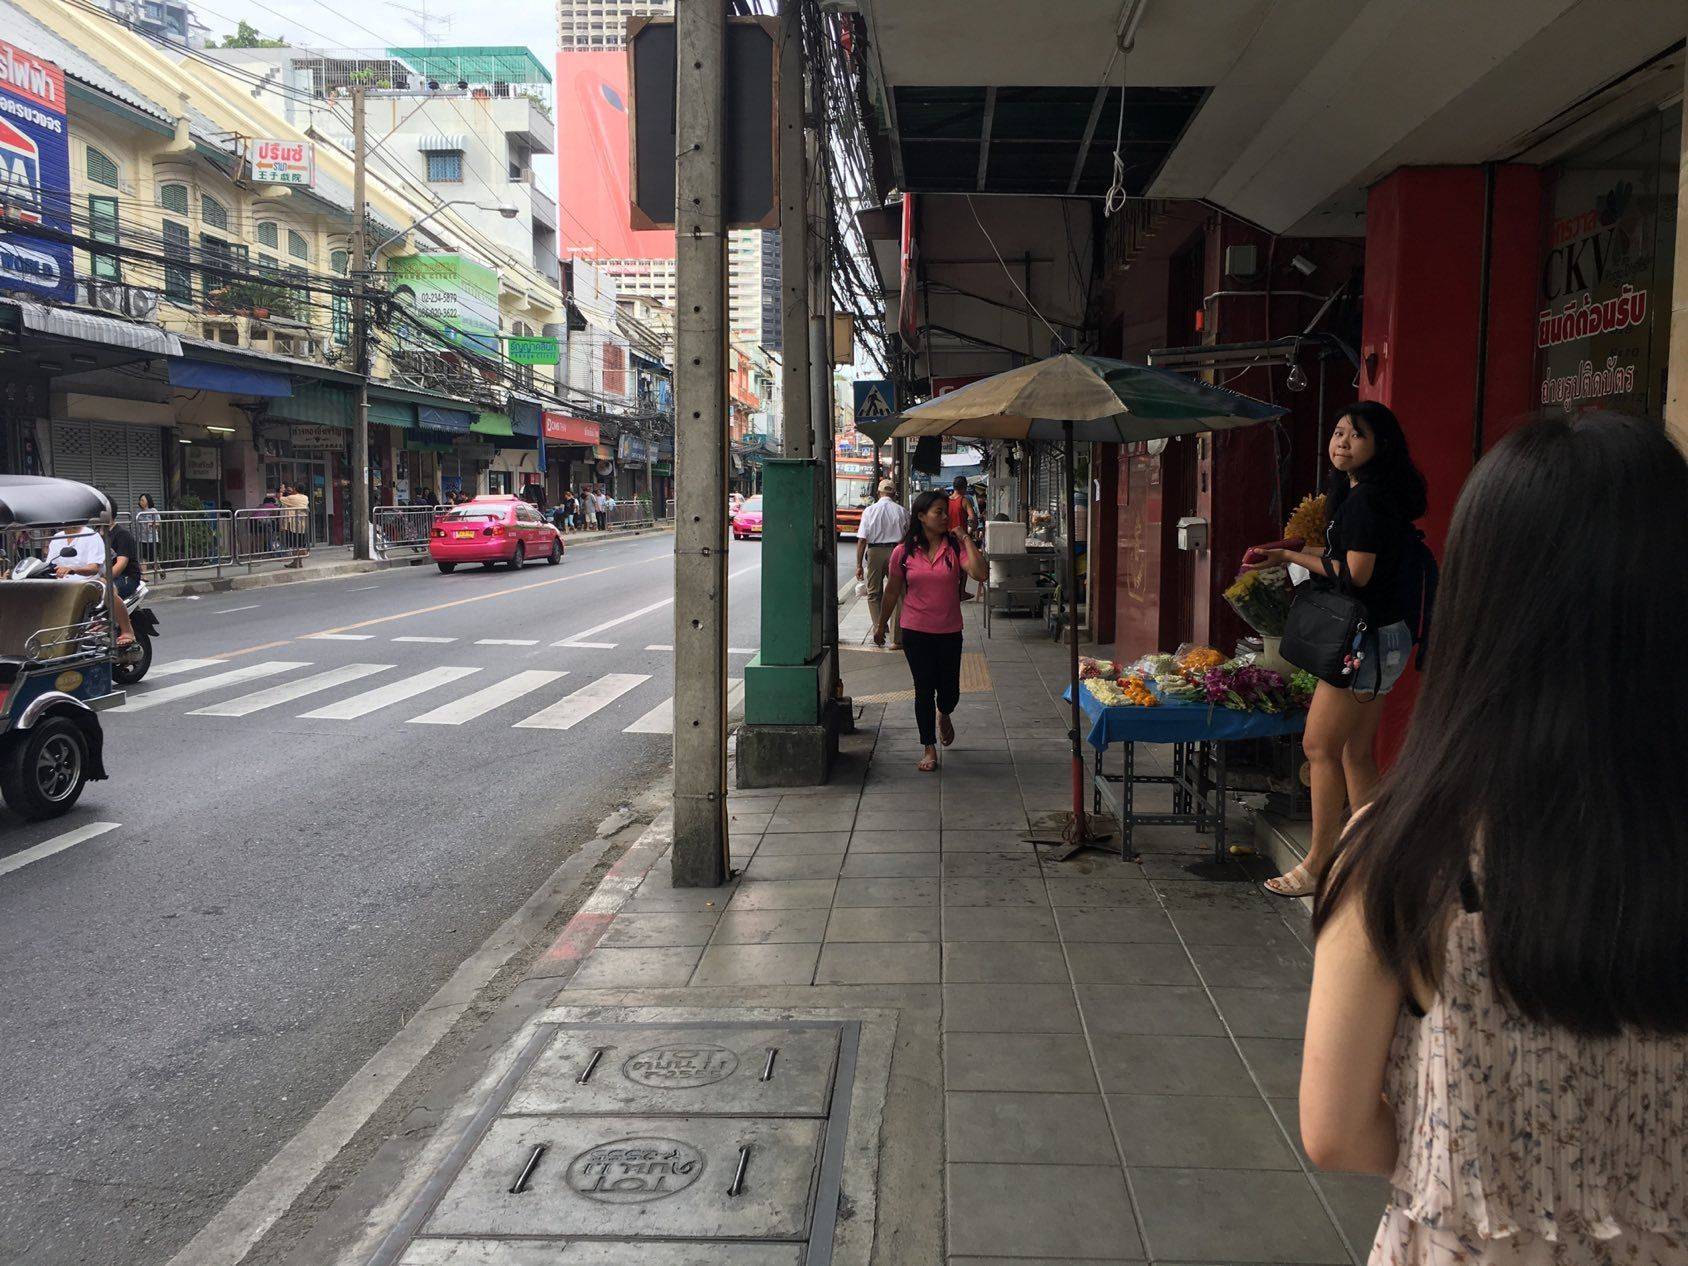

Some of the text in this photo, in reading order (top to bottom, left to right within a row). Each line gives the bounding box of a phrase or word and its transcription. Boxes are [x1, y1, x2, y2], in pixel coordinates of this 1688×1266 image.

[1538, 285, 1647, 348] ยินดีต้อนรับ
[1541, 356, 1634, 413] ถ่ายรูปติดบัตร
